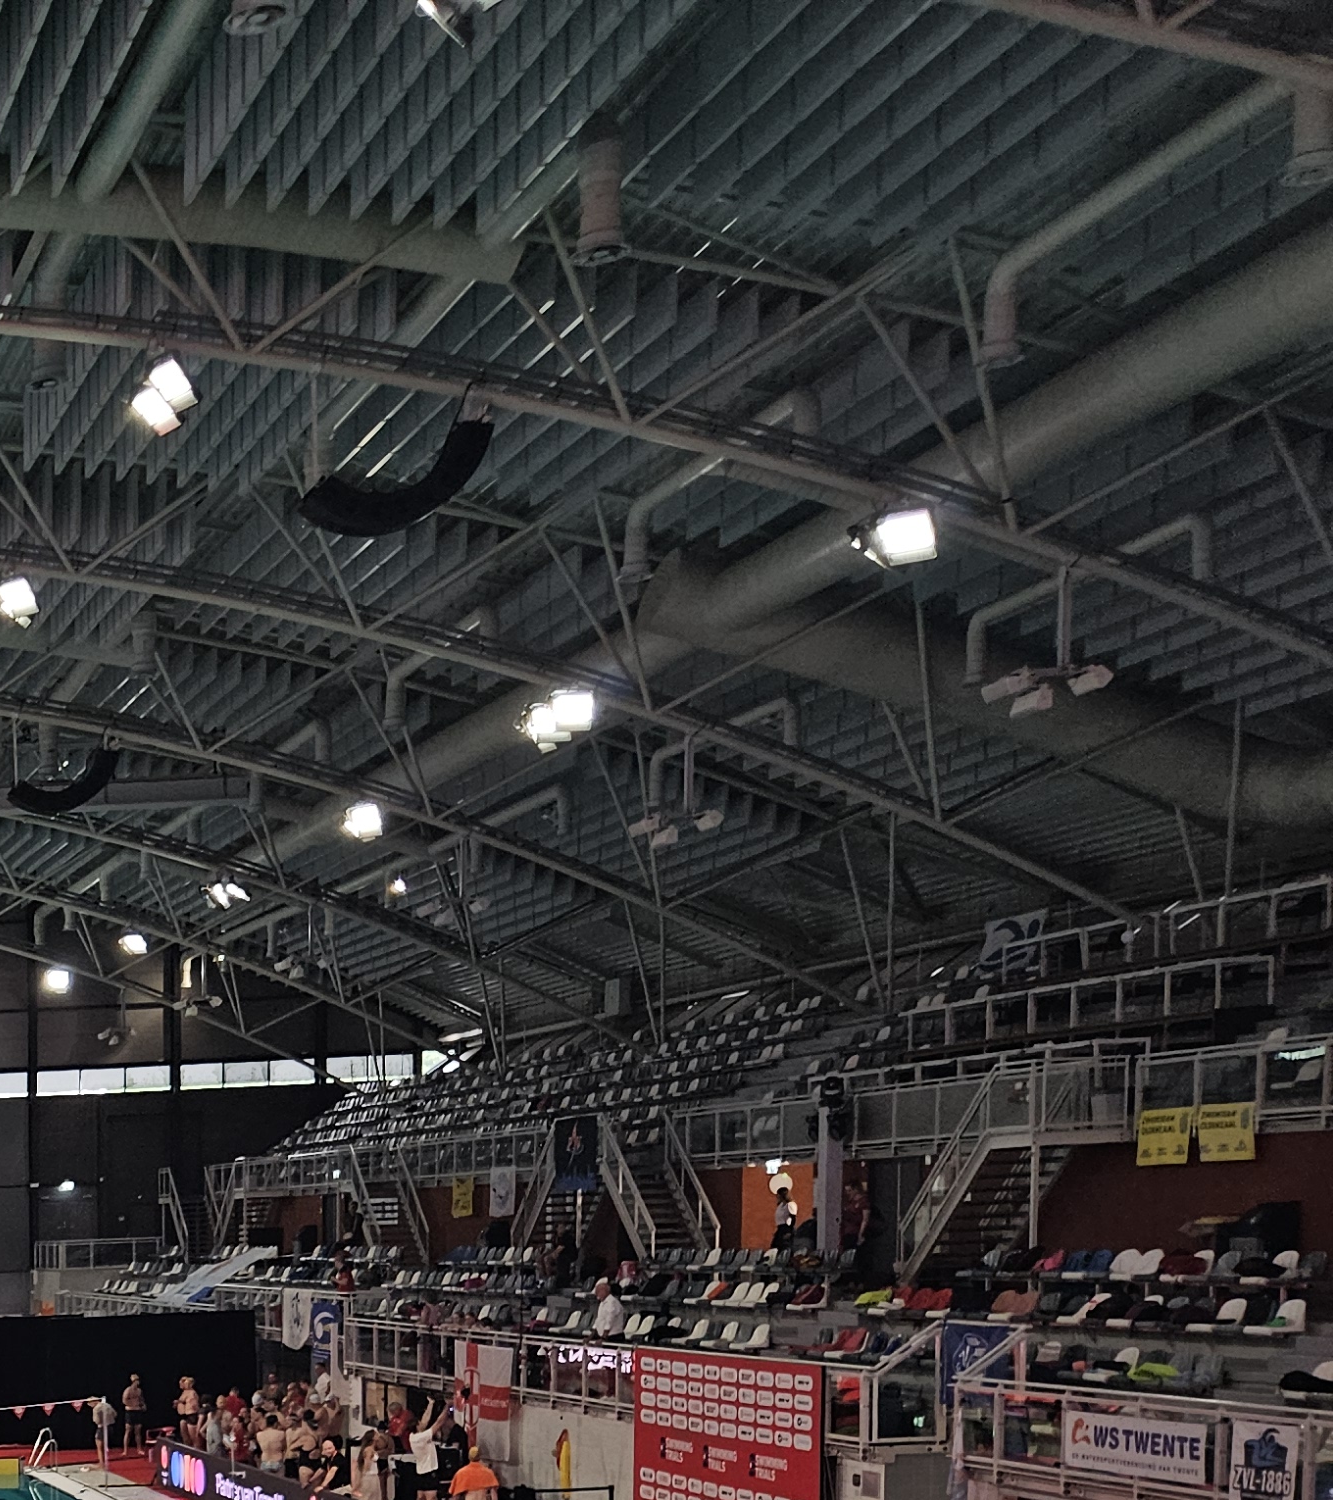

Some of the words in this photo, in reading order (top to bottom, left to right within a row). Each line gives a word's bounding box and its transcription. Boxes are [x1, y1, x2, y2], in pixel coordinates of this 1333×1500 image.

[1094, 1425, 1120, 1450] WS
[1122, 1429, 1201, 1461] TWENTE
[1234, 1466, 1291, 1495] ZVL-1886
